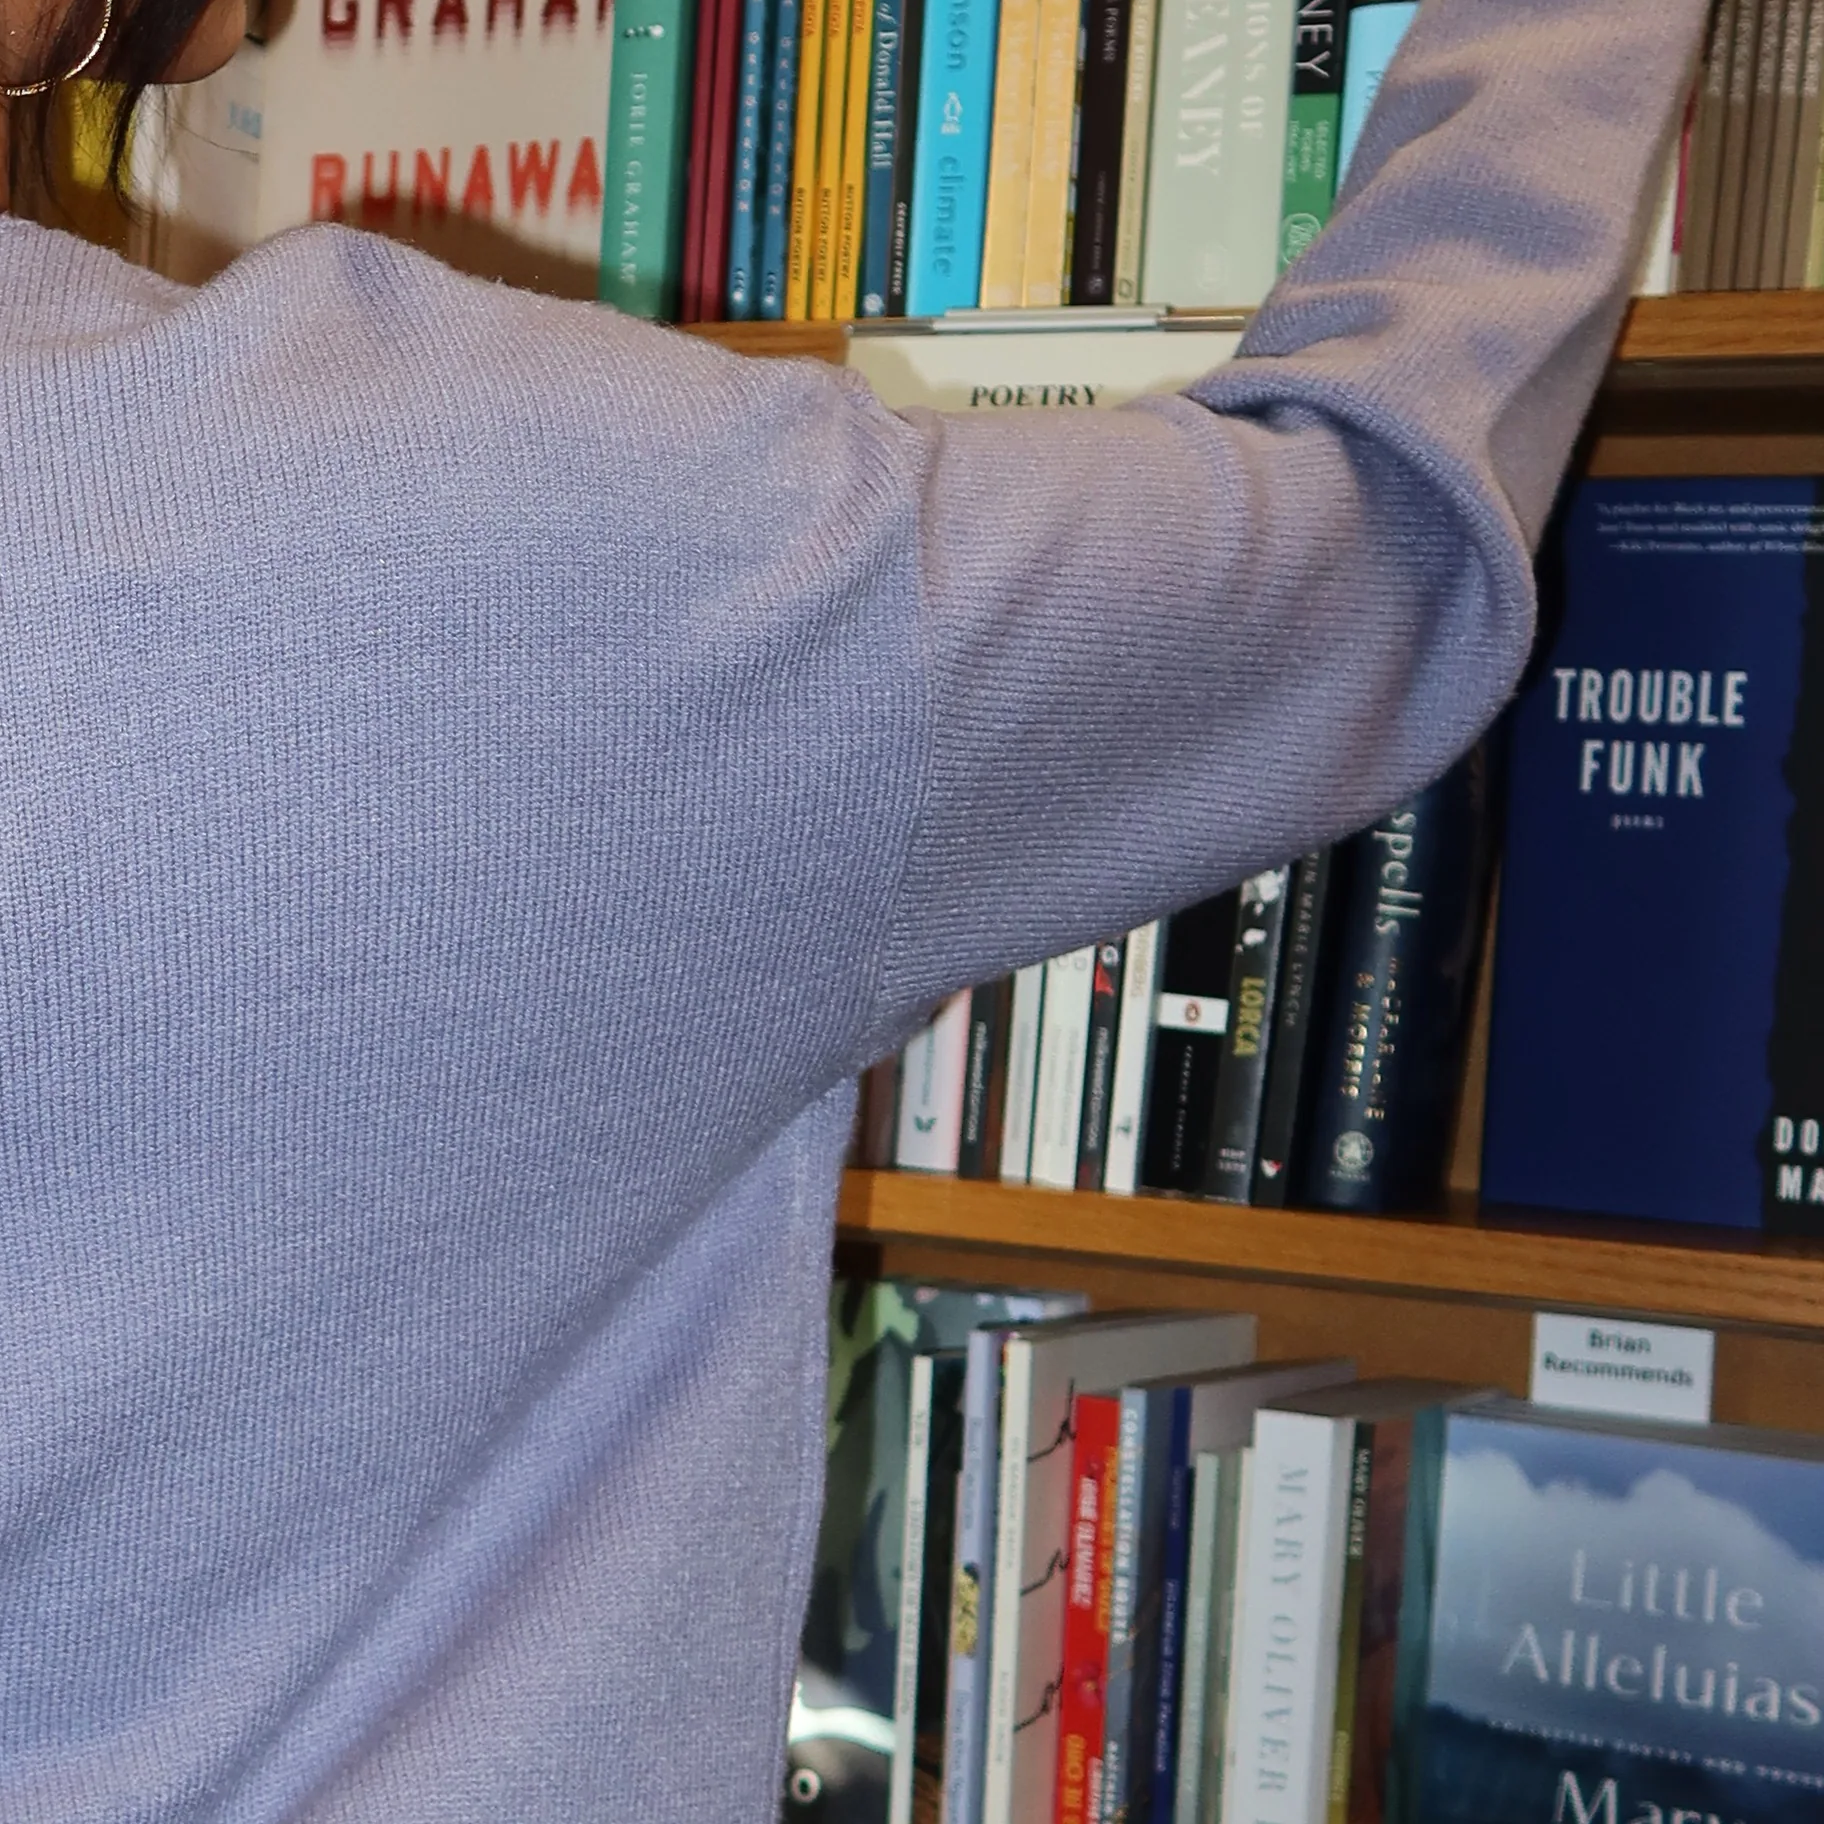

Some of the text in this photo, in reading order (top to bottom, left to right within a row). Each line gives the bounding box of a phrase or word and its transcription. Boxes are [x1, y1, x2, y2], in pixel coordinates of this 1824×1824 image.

[877, 3, 894, 23] of
[1101, 7, 1120, 64] POEMS
[873, 29, 900, 113] Donald
[870, 118, 894, 171] Hall
[1237, 94, 1268, 139] OF
[620, 72, 650, 286] JORIE GRAHAM
[932, 155, 969, 280] climate
[790, 187, 806, 283] BUTTON POETRY
[816, 188, 833, 284] BUTTON POETRY
[840, 183, 857, 281] BUTTON POETRY
[969, 383, 1103, 408] POETRY
[1552, 667, 1750, 728] TROUBLE
[1578, 738, 1707, 797] FUNK
[1374, 811, 1424, 938] spells
[1233, 976, 1268, 1057] LORCA
[1541, 1350, 1695, 1388] Recommends
[1586, 1327, 1653, 1355] Brian
[1116, 1407, 1138, 1570] CONSTELLATION
[1270, 1462, 1311, 1588] MARY
[1569, 1548, 1765, 1631] Little
[1256, 1612, 1304, 1796] OLIVER
[1501, 1624, 1822, 1728] Alleluias
